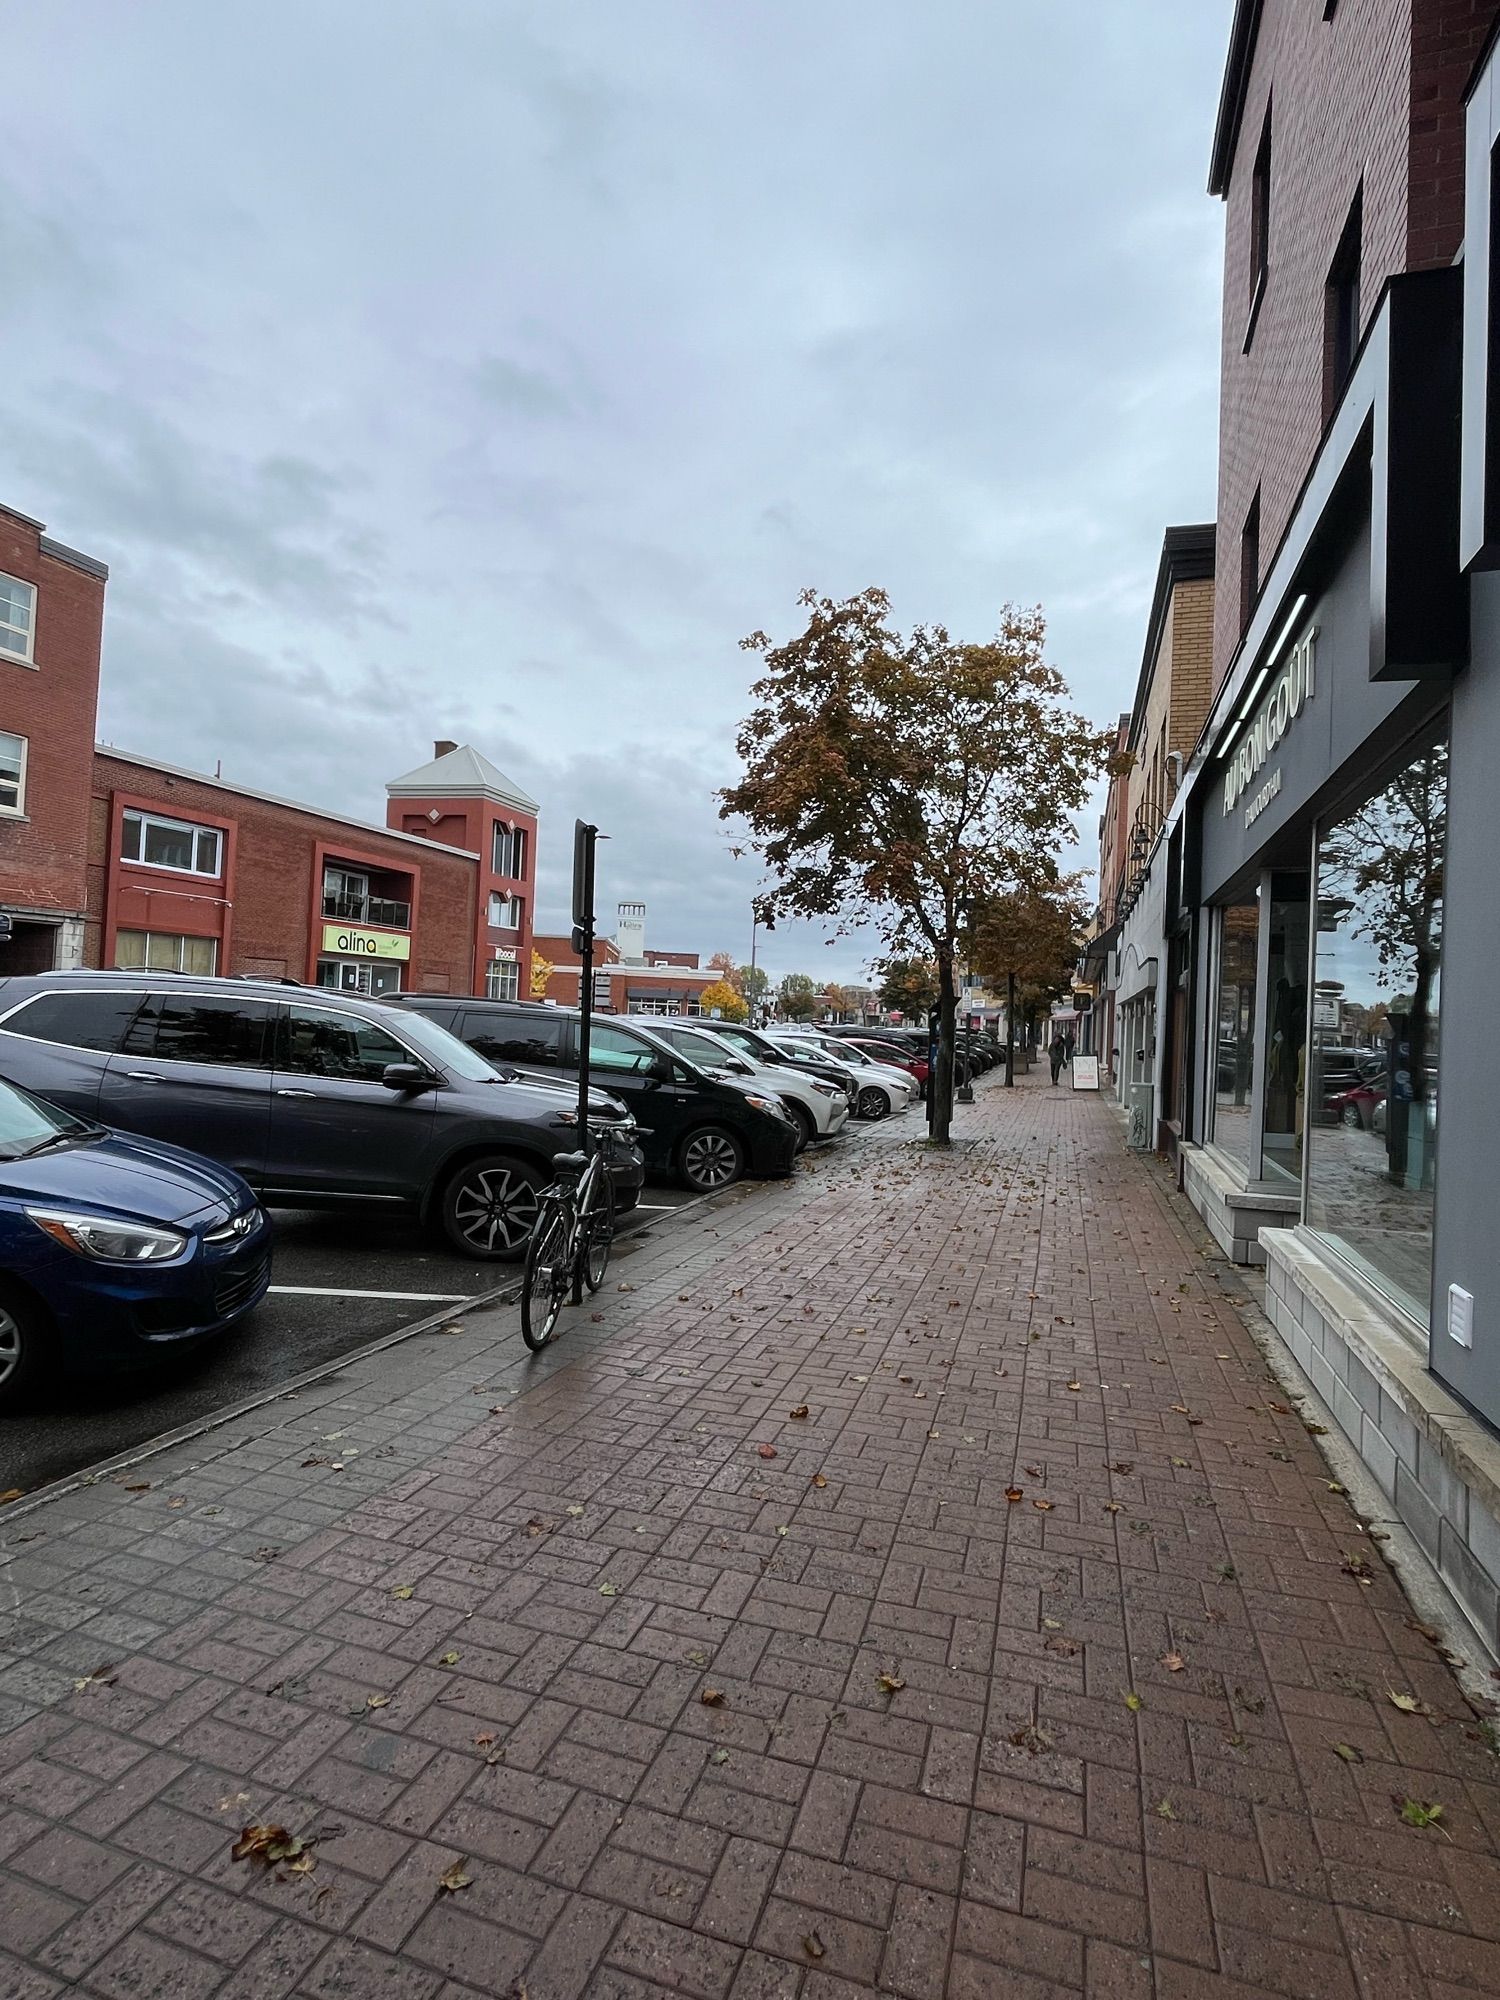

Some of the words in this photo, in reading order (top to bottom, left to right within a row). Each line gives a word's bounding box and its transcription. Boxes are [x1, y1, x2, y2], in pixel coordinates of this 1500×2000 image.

[1223, 760, 1239, 817] AU
[1239, 714, 1266, 795] BON
[1266, 626, 1320, 752] GOÛT
[337, 931, 376, 953] alina
